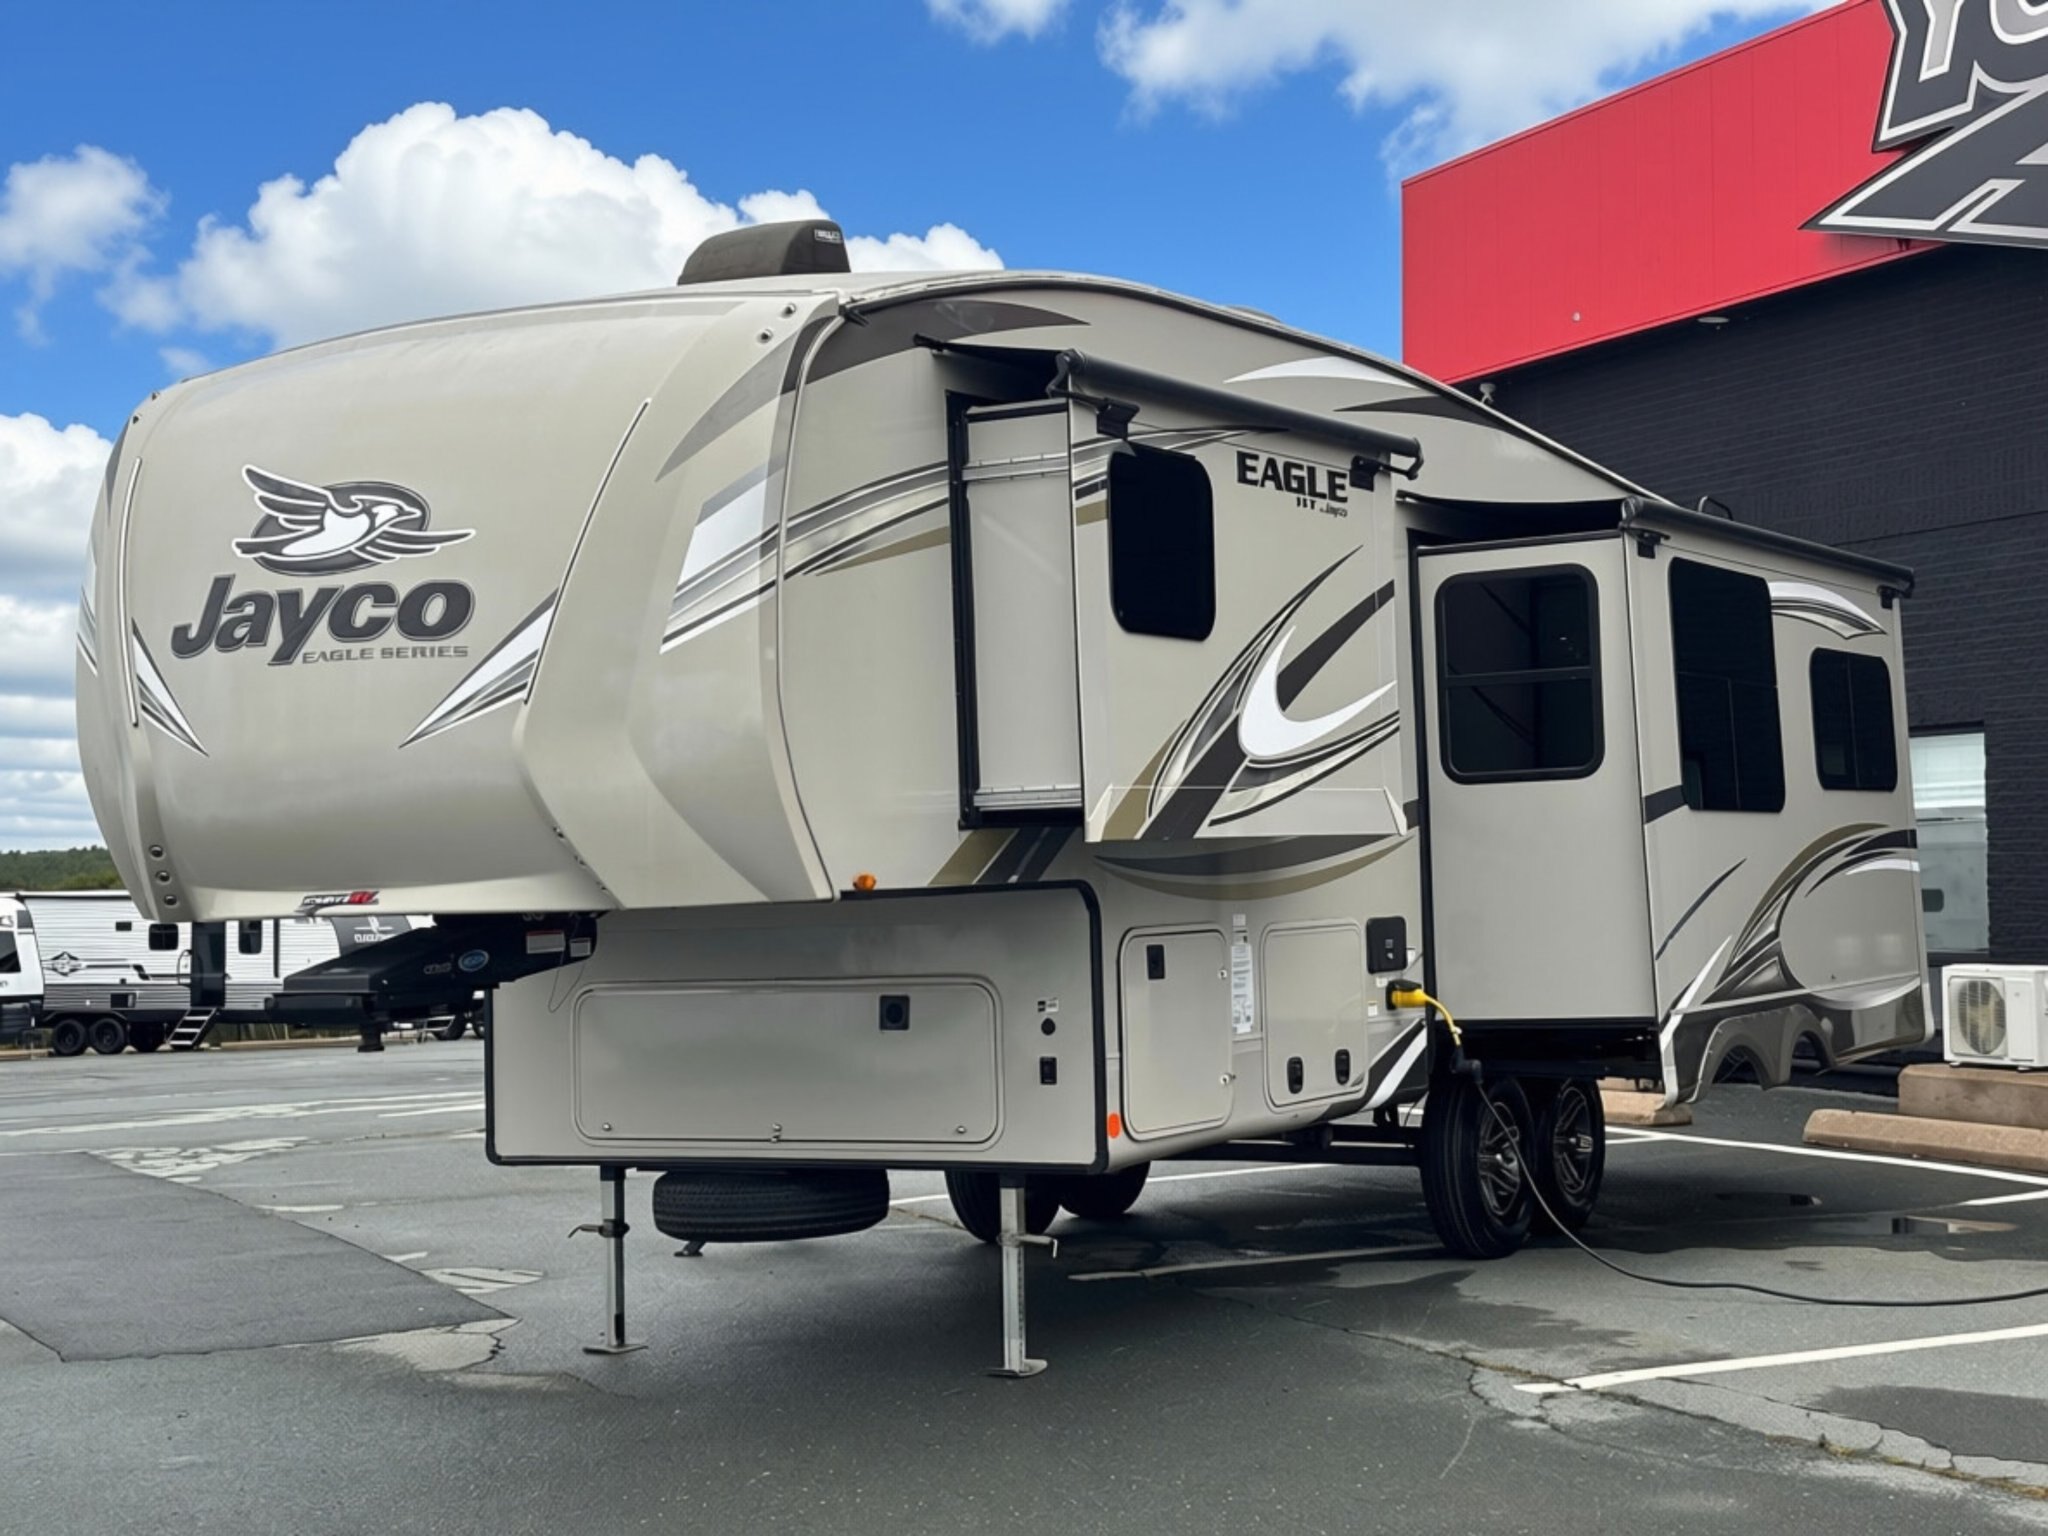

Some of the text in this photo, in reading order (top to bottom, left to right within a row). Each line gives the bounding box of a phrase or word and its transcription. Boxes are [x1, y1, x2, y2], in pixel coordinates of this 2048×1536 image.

[1236, 450, 1348, 503] EAGLE
[171, 574, 475, 666] Jayco
[302, 645, 469, 664] EAGLE SERIES
